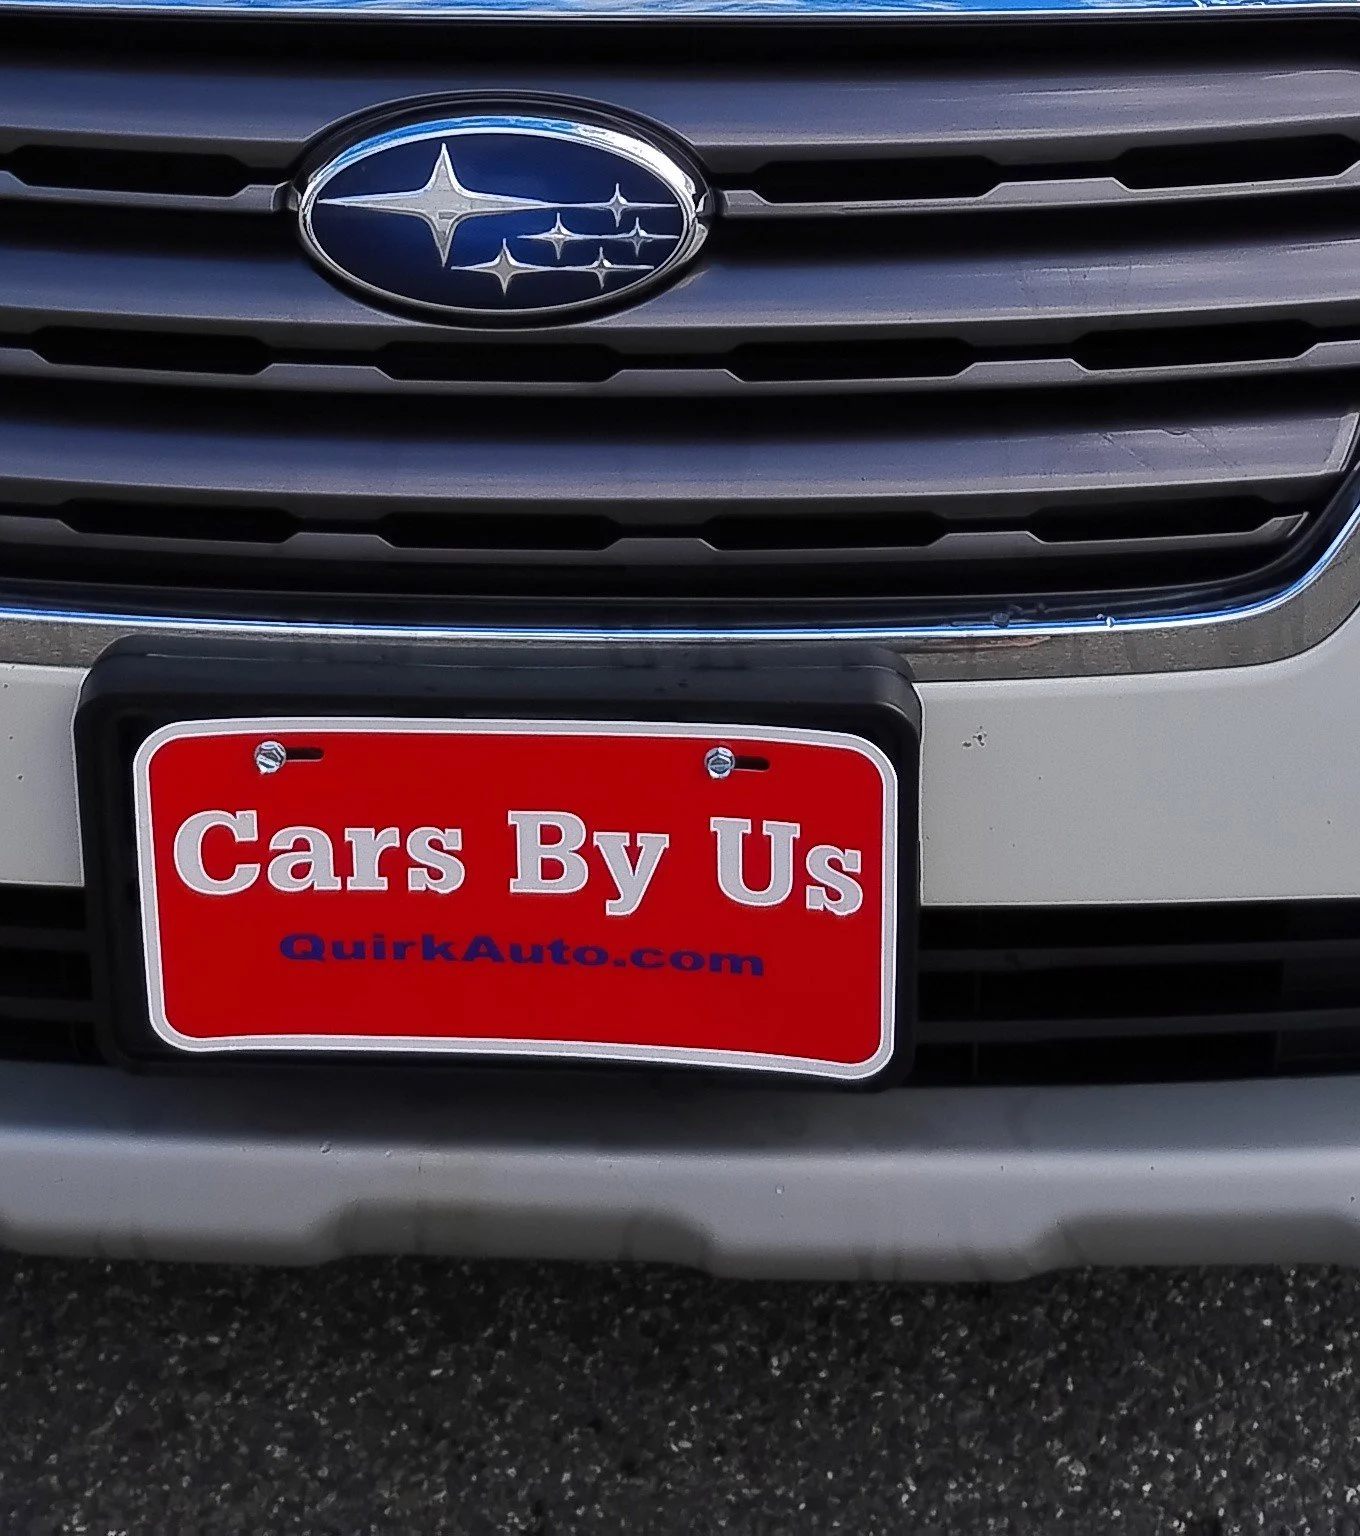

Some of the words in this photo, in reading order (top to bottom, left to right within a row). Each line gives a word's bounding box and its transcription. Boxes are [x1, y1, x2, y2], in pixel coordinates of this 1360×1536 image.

[173, 809, 466, 896] Cars
[507, 809, 670, 917] By
[709, 816, 864, 917] Us
[279, 932, 764, 977] QuirkAuto.com
